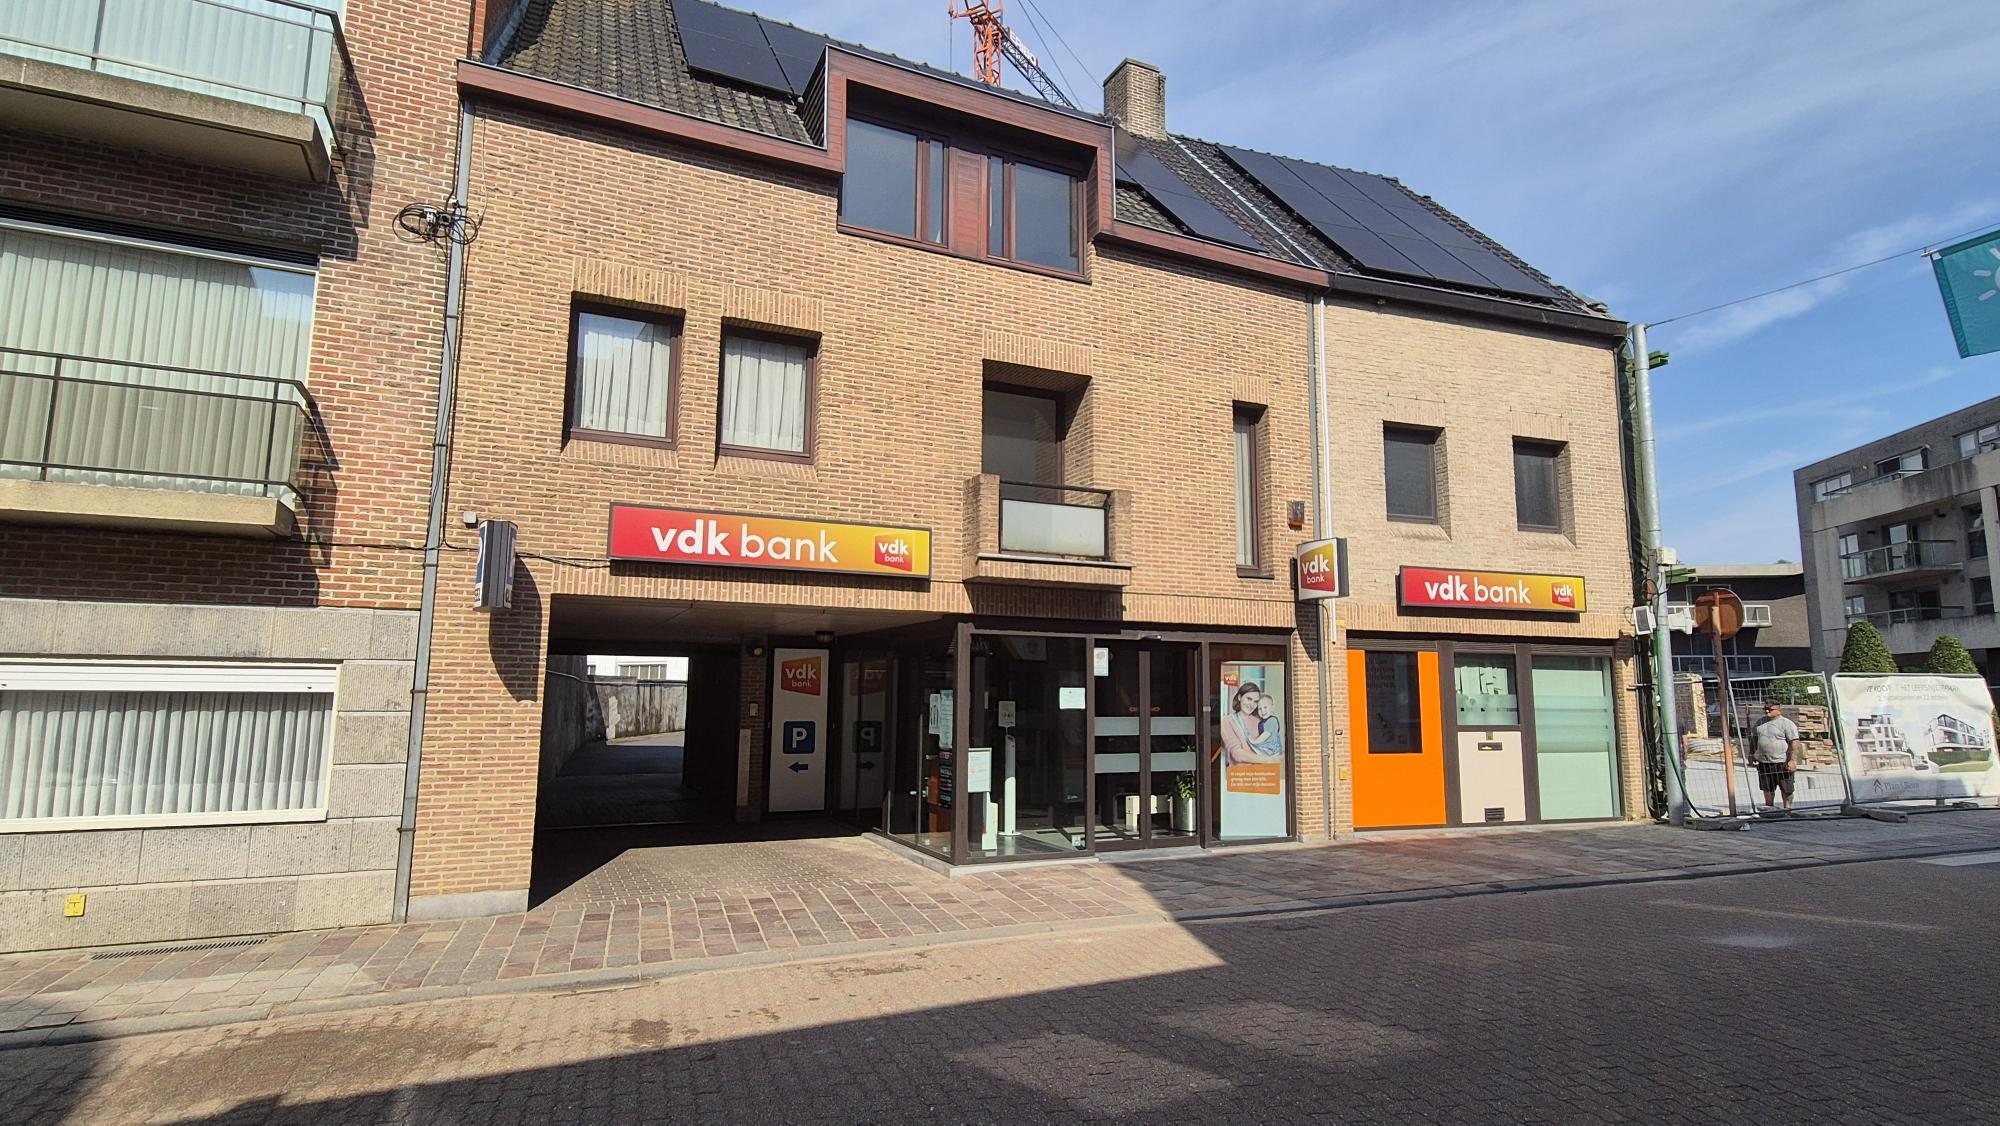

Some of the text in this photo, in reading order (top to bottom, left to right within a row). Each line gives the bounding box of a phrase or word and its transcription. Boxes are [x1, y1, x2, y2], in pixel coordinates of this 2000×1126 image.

[651, 518, 838, 563] vdk bank
[877, 538, 910, 556] vdk
[884, 554, 904, 564] bank
[1302, 553, 1330, 575] vdk
[1306, 574, 1325, 585] bank
[1424, 574, 1531, 604] vdk bank
[1553, 584, 1573, 596] vdk
[785, 664, 817, 680] vdk
[791, 679, 812, 688] bank
[792, 727, 808, 749] P
